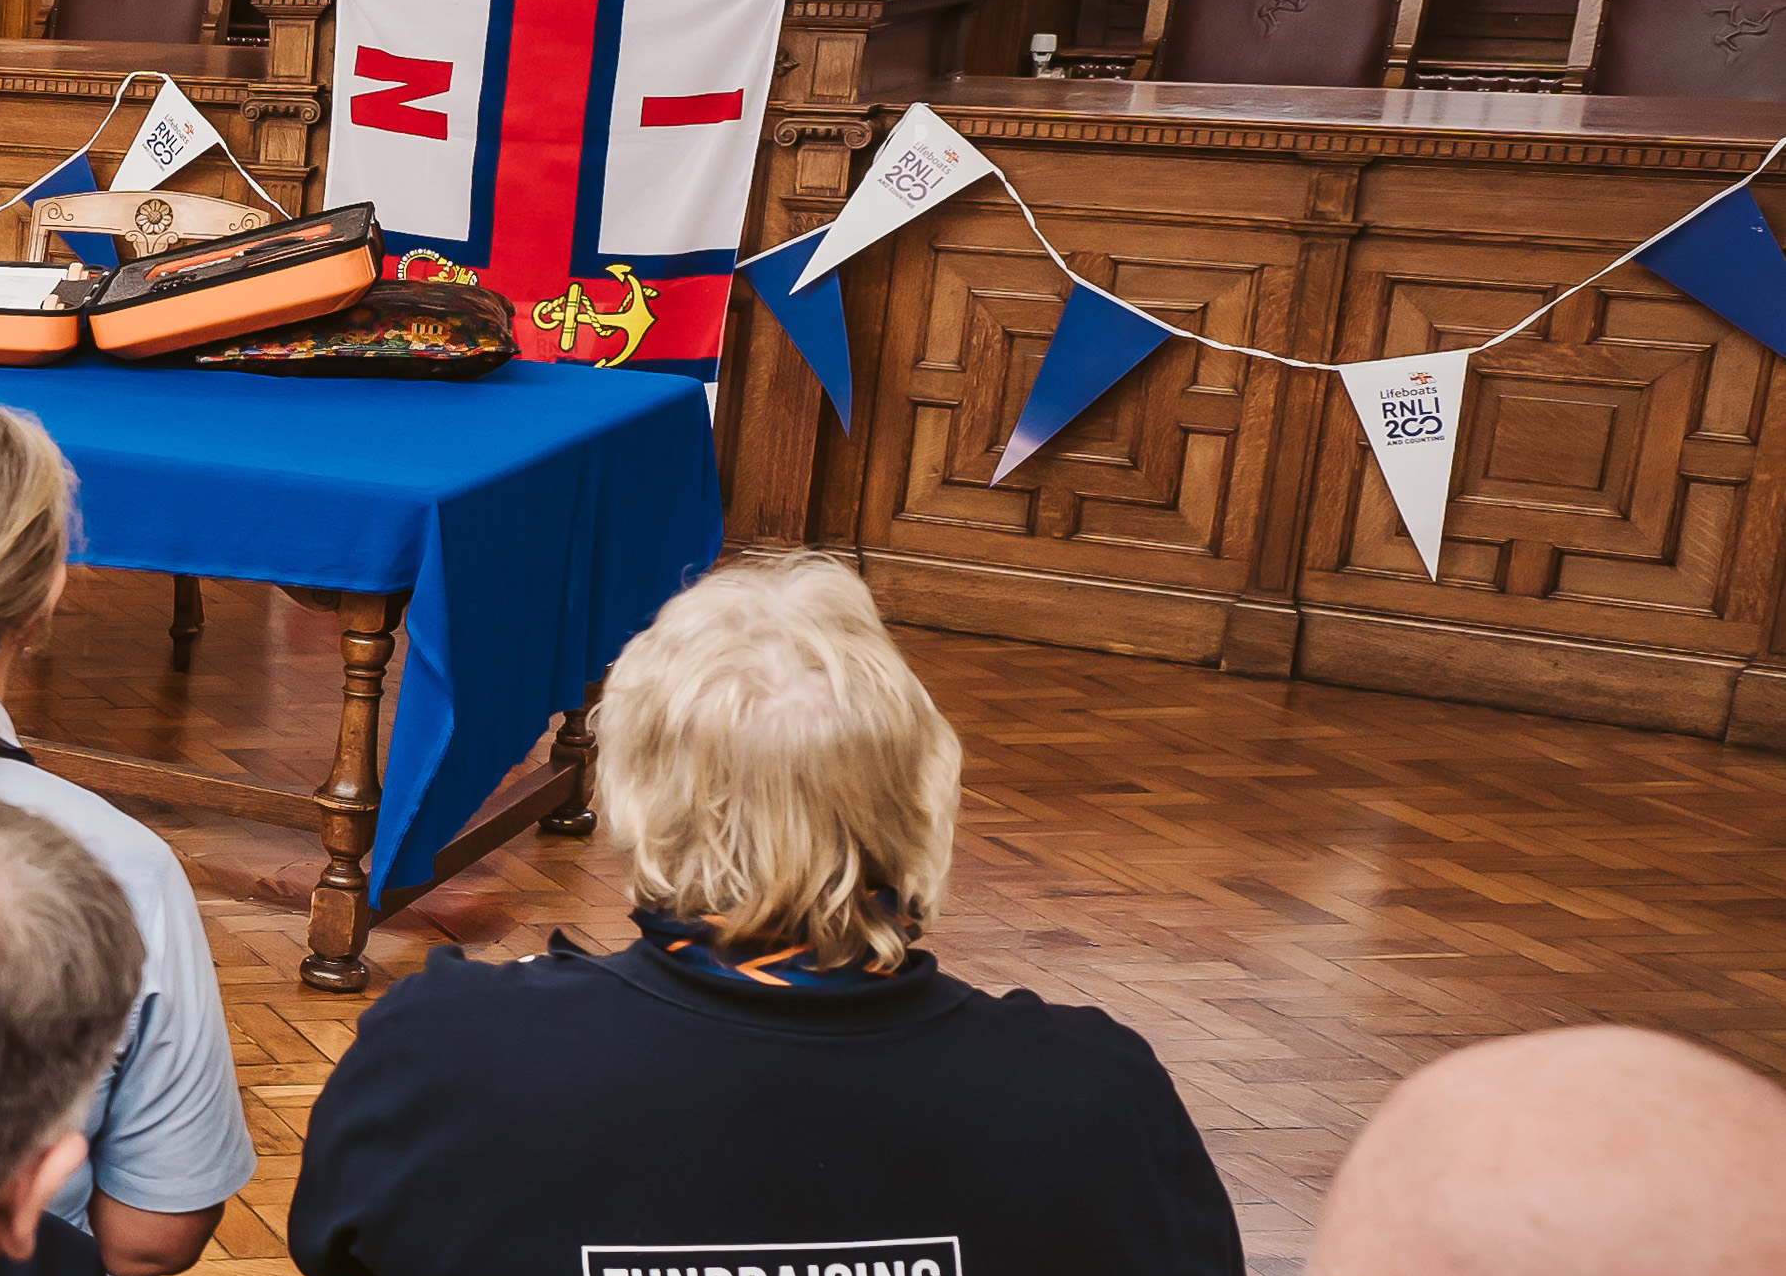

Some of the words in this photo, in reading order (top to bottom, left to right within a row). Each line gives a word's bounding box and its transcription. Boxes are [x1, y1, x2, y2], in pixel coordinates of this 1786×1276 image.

[155, 120, 185, 156] RNLI
[898, 149, 944, 189] RNLI
[912, 141, 952, 175] Lifeboats
[1380, 386, 1438, 400] Lifeboats
[1381, 396, 1441, 419] RNLI
[1404, 435, 1446, 445] COUNTING
